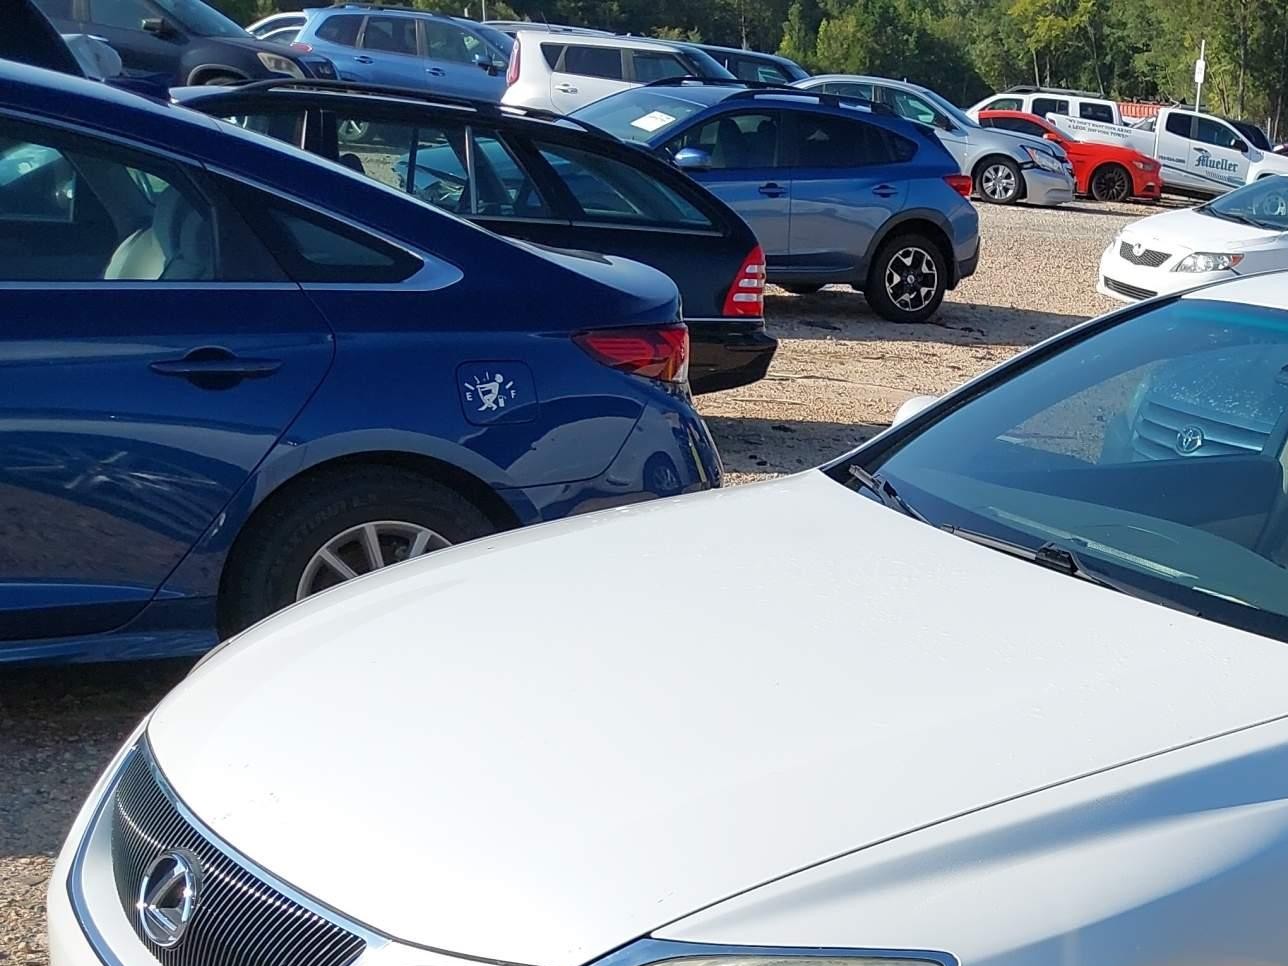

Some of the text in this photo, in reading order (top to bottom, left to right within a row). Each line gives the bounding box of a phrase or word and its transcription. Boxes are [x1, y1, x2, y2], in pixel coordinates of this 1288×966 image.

[1195, 152, 1239, 173] Mueller
[465, 390, 517, 401] E F
